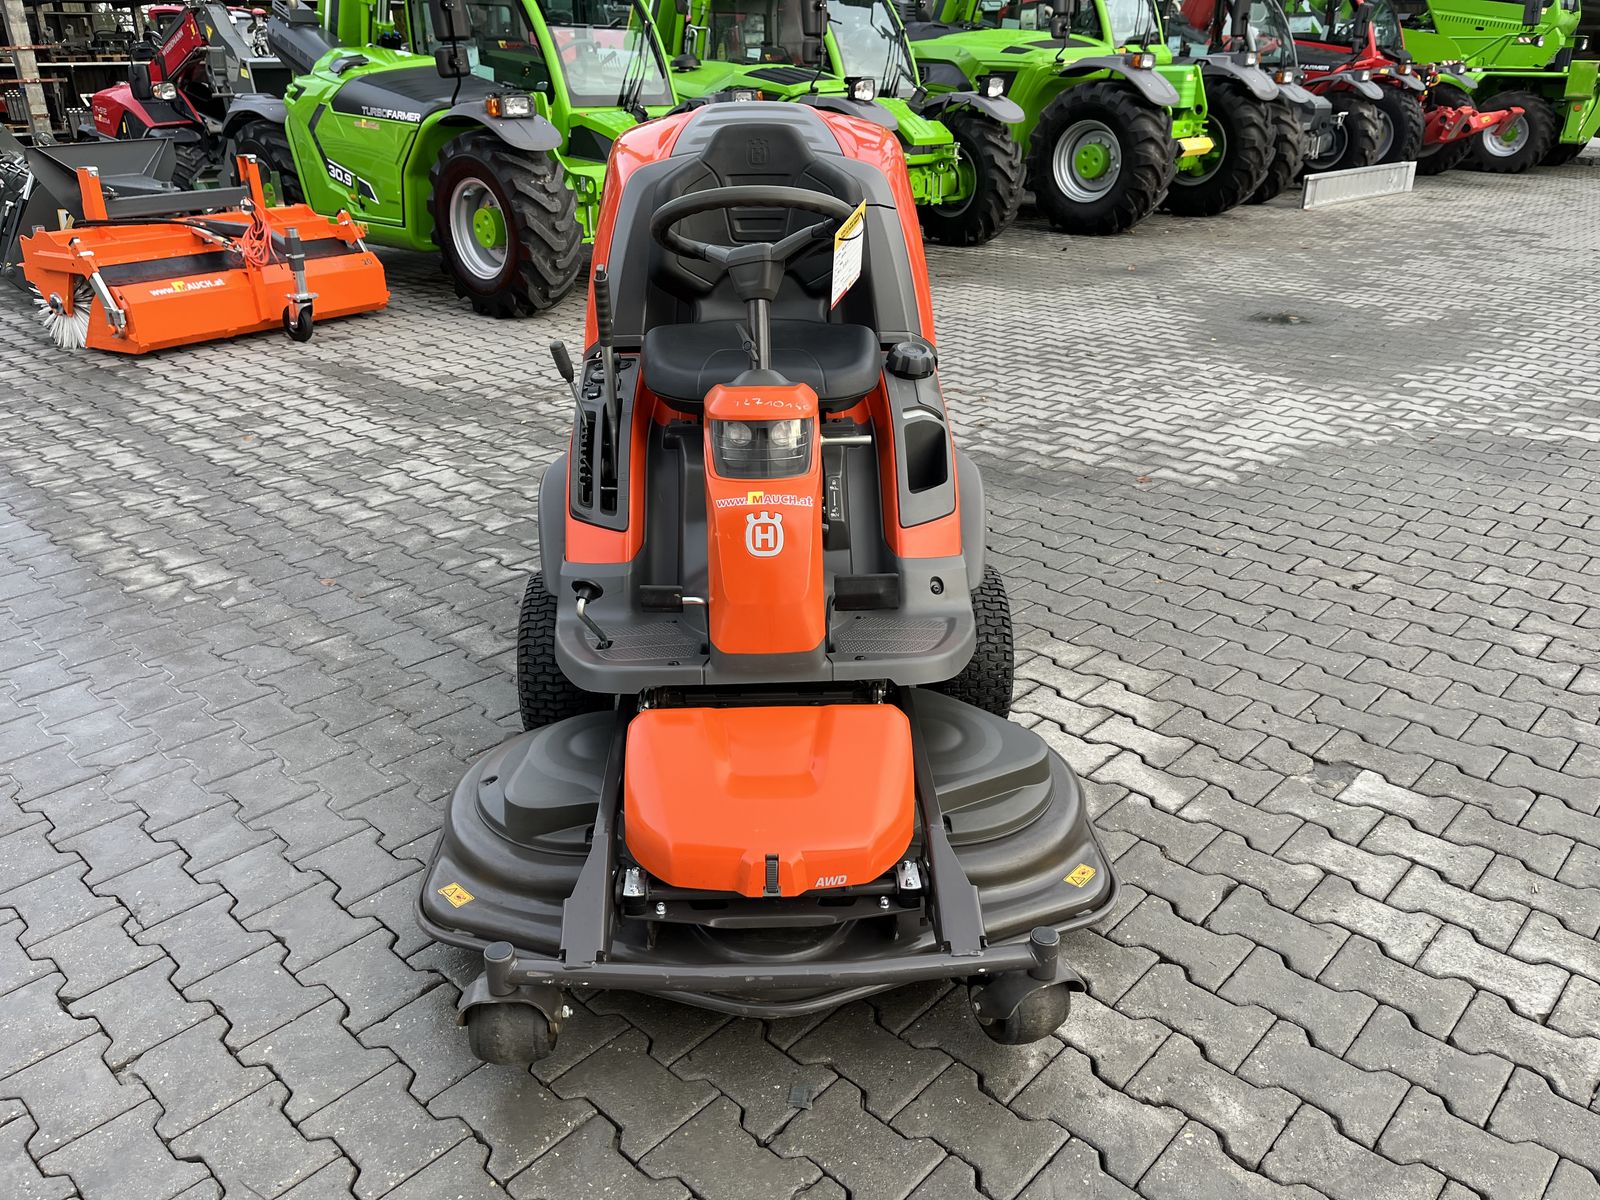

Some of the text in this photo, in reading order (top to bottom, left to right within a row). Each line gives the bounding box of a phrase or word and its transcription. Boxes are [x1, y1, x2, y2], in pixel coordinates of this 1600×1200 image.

[361, 105, 421, 122] TURBOFARMER
[328, 164, 352, 187] 30.9
[815, 874, 848, 888] AWD
